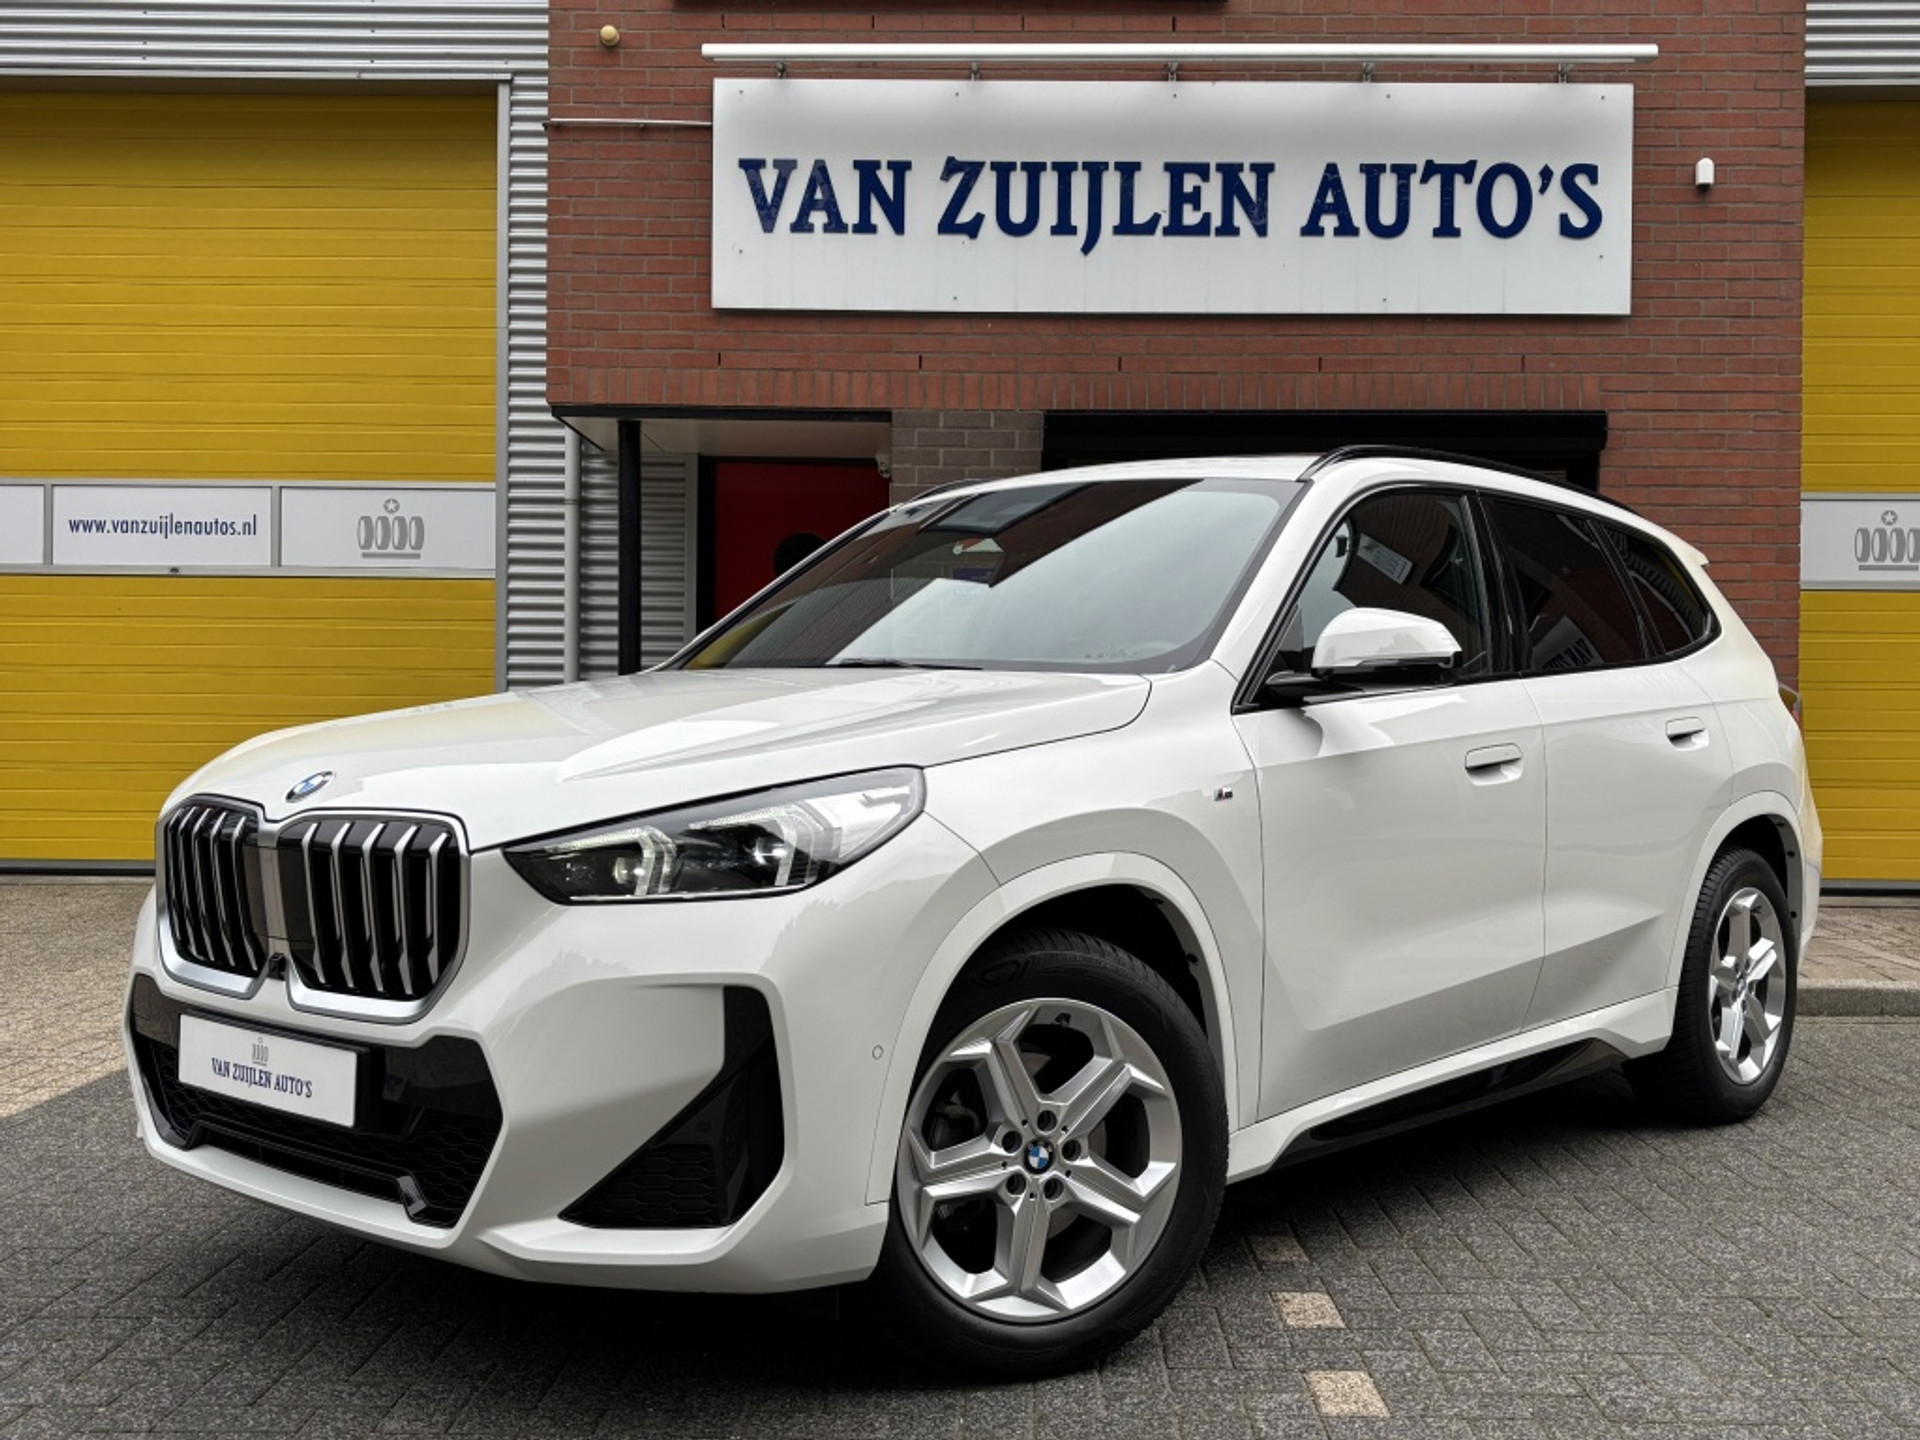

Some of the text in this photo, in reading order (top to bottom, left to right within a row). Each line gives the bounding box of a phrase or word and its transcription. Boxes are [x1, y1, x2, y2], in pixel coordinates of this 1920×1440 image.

[738, 155, 1604, 257] VAN ZUIJLEN AUTO'S
[68, 512, 257, 540] www.vanzuijlenautos.nl
[211, 1057, 313, 1098] VAN ZUIJLEN AUTO'S
